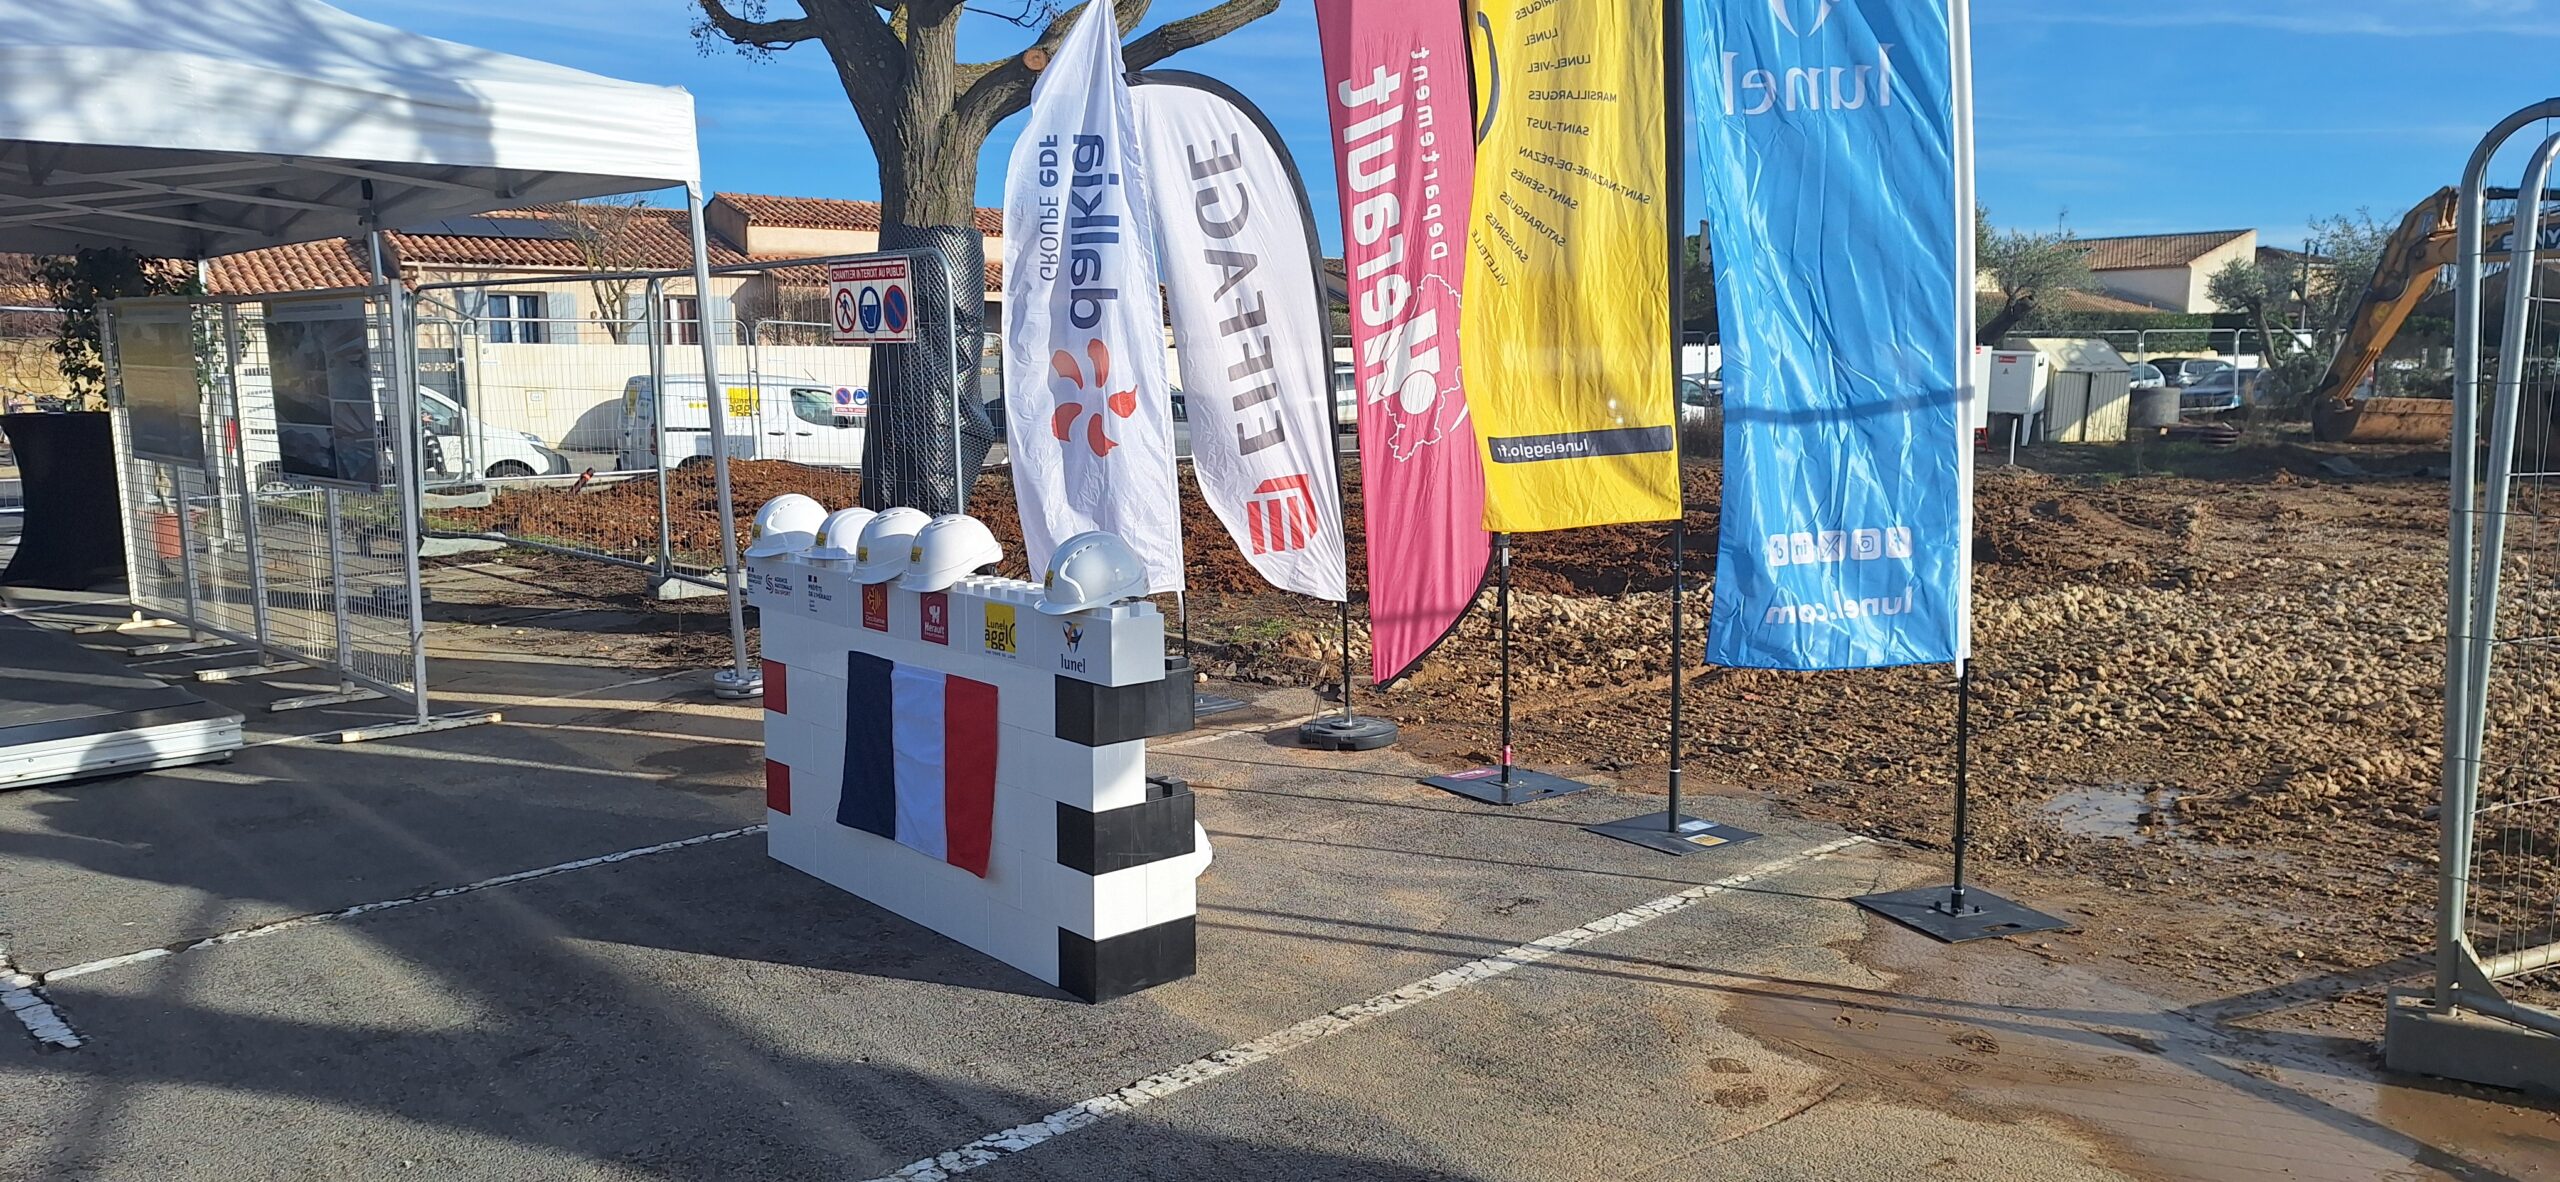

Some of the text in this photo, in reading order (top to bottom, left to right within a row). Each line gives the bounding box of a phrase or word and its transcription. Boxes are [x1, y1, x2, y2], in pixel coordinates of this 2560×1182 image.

[833, 266, 905, 280] CHANTIER INTERDIT AU PUBLIC
[729, 396, 751, 404] Lune
[986, 615, 1005, 630] Lunel
[1060, 653, 1086, 674] lunel
